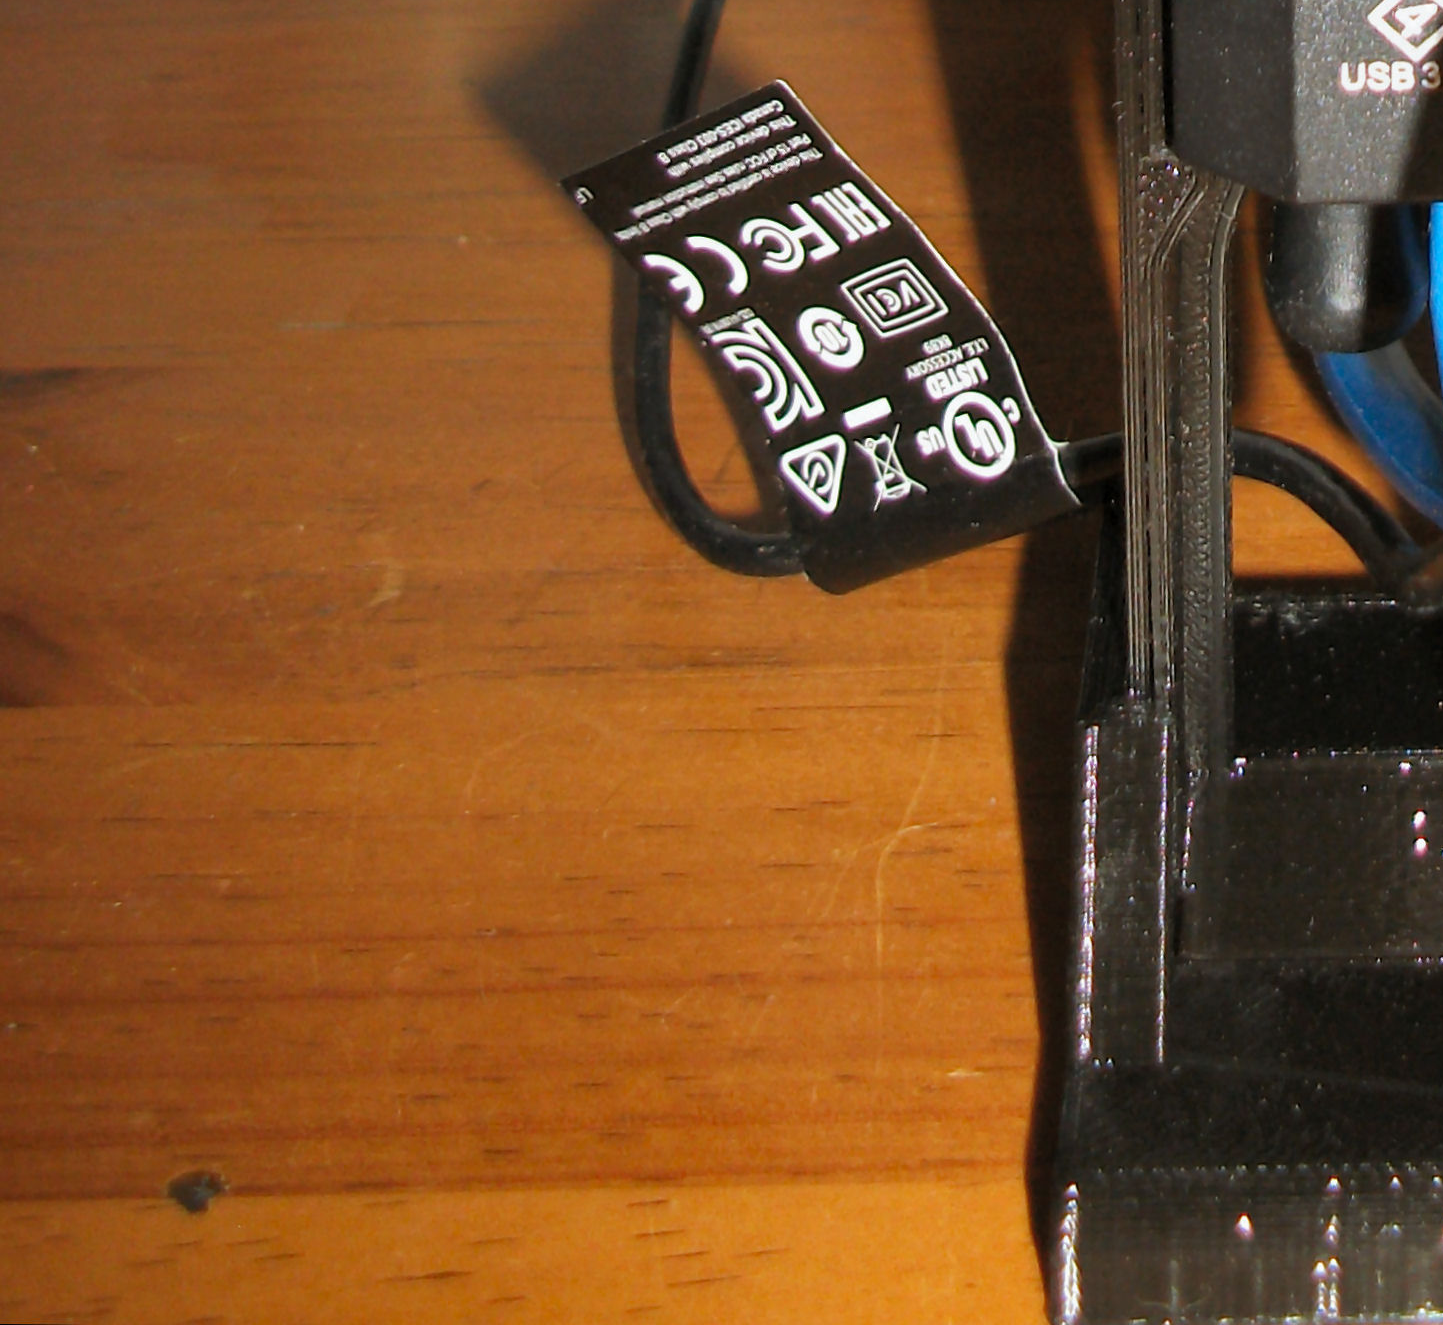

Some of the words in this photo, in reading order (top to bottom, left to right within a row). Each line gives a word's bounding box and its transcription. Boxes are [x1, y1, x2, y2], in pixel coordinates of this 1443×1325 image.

[1338, 60, 1416, 93] USB
[740, 99, 784, 124] Canada
[768, 114, 797, 132] This
[666, 139, 699, 158] Class
[734, 125, 770, 147] device
[656, 152, 671, 165] B
[689, 140, 736, 168] complies
[799, 147, 823, 162] This
[905, 347, 965, 380] ACCESSORY
[925, 357, 989, 400] LISTED
[916, 425, 946, 457] US
